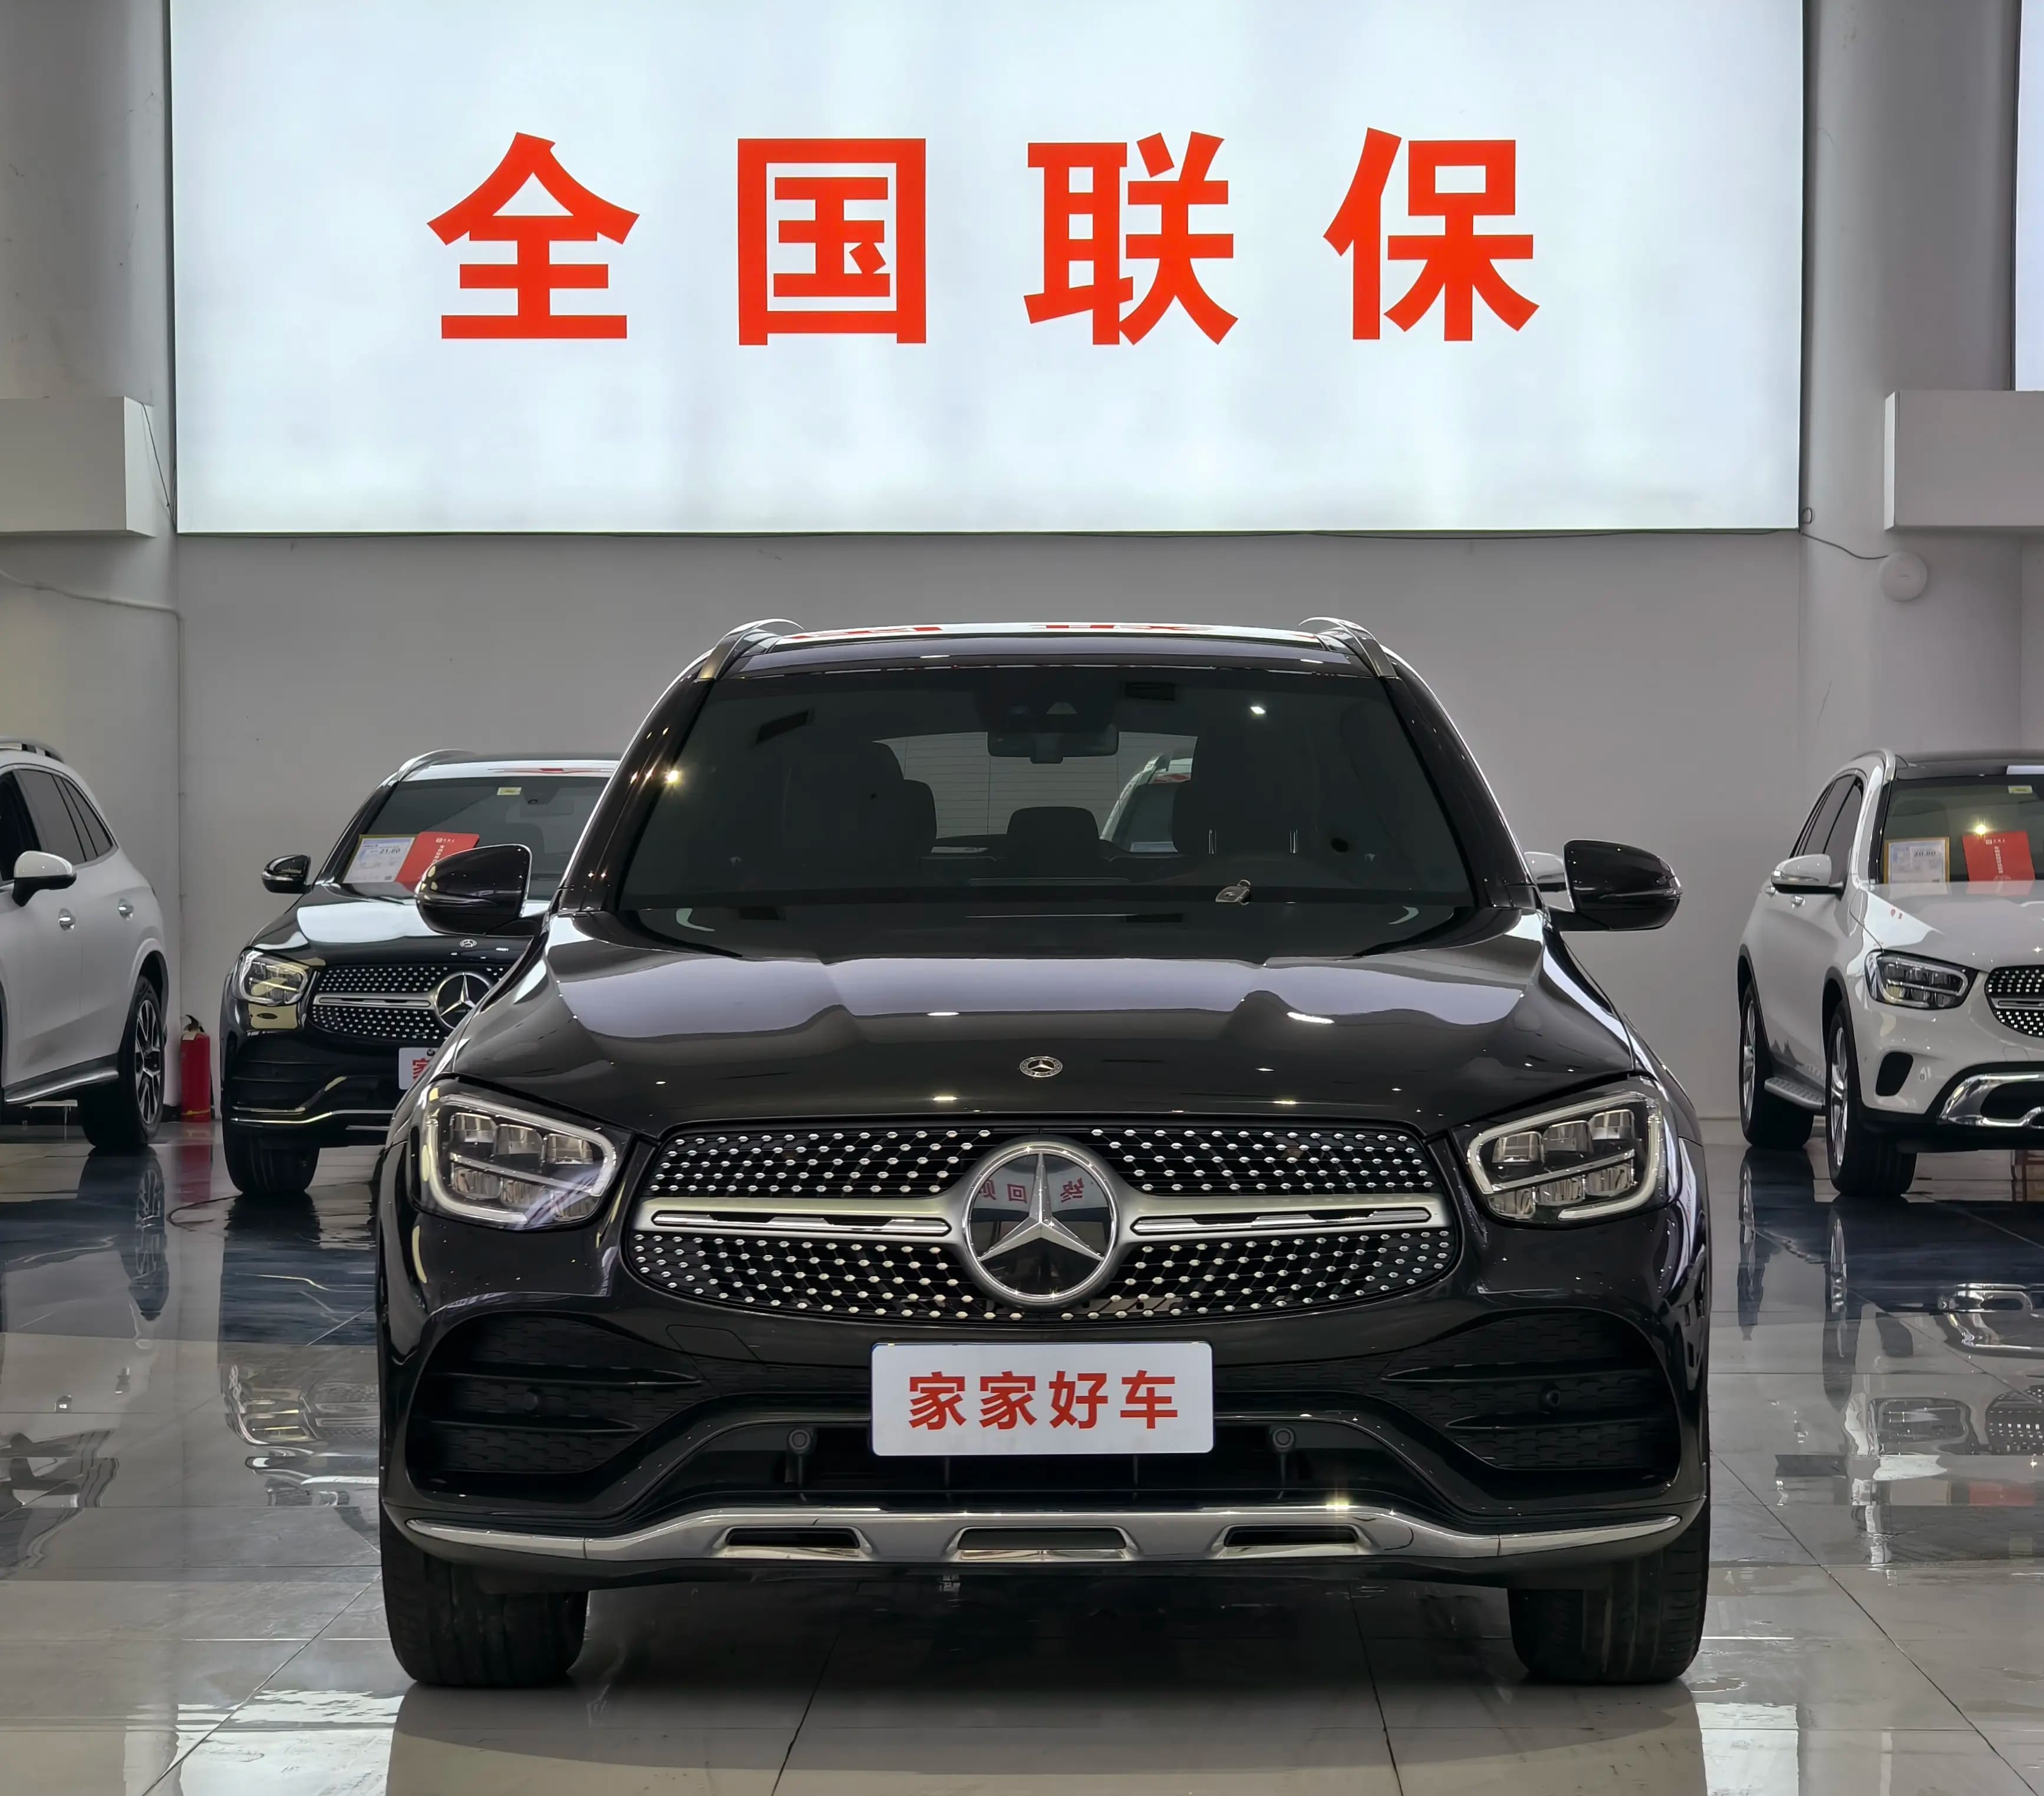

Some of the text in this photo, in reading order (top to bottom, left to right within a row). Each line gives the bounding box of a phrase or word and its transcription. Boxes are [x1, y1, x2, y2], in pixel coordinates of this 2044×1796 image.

[428, 127, 1539, 345] 全国联保
[908, 1370, 1178, 1430] 家家好车
